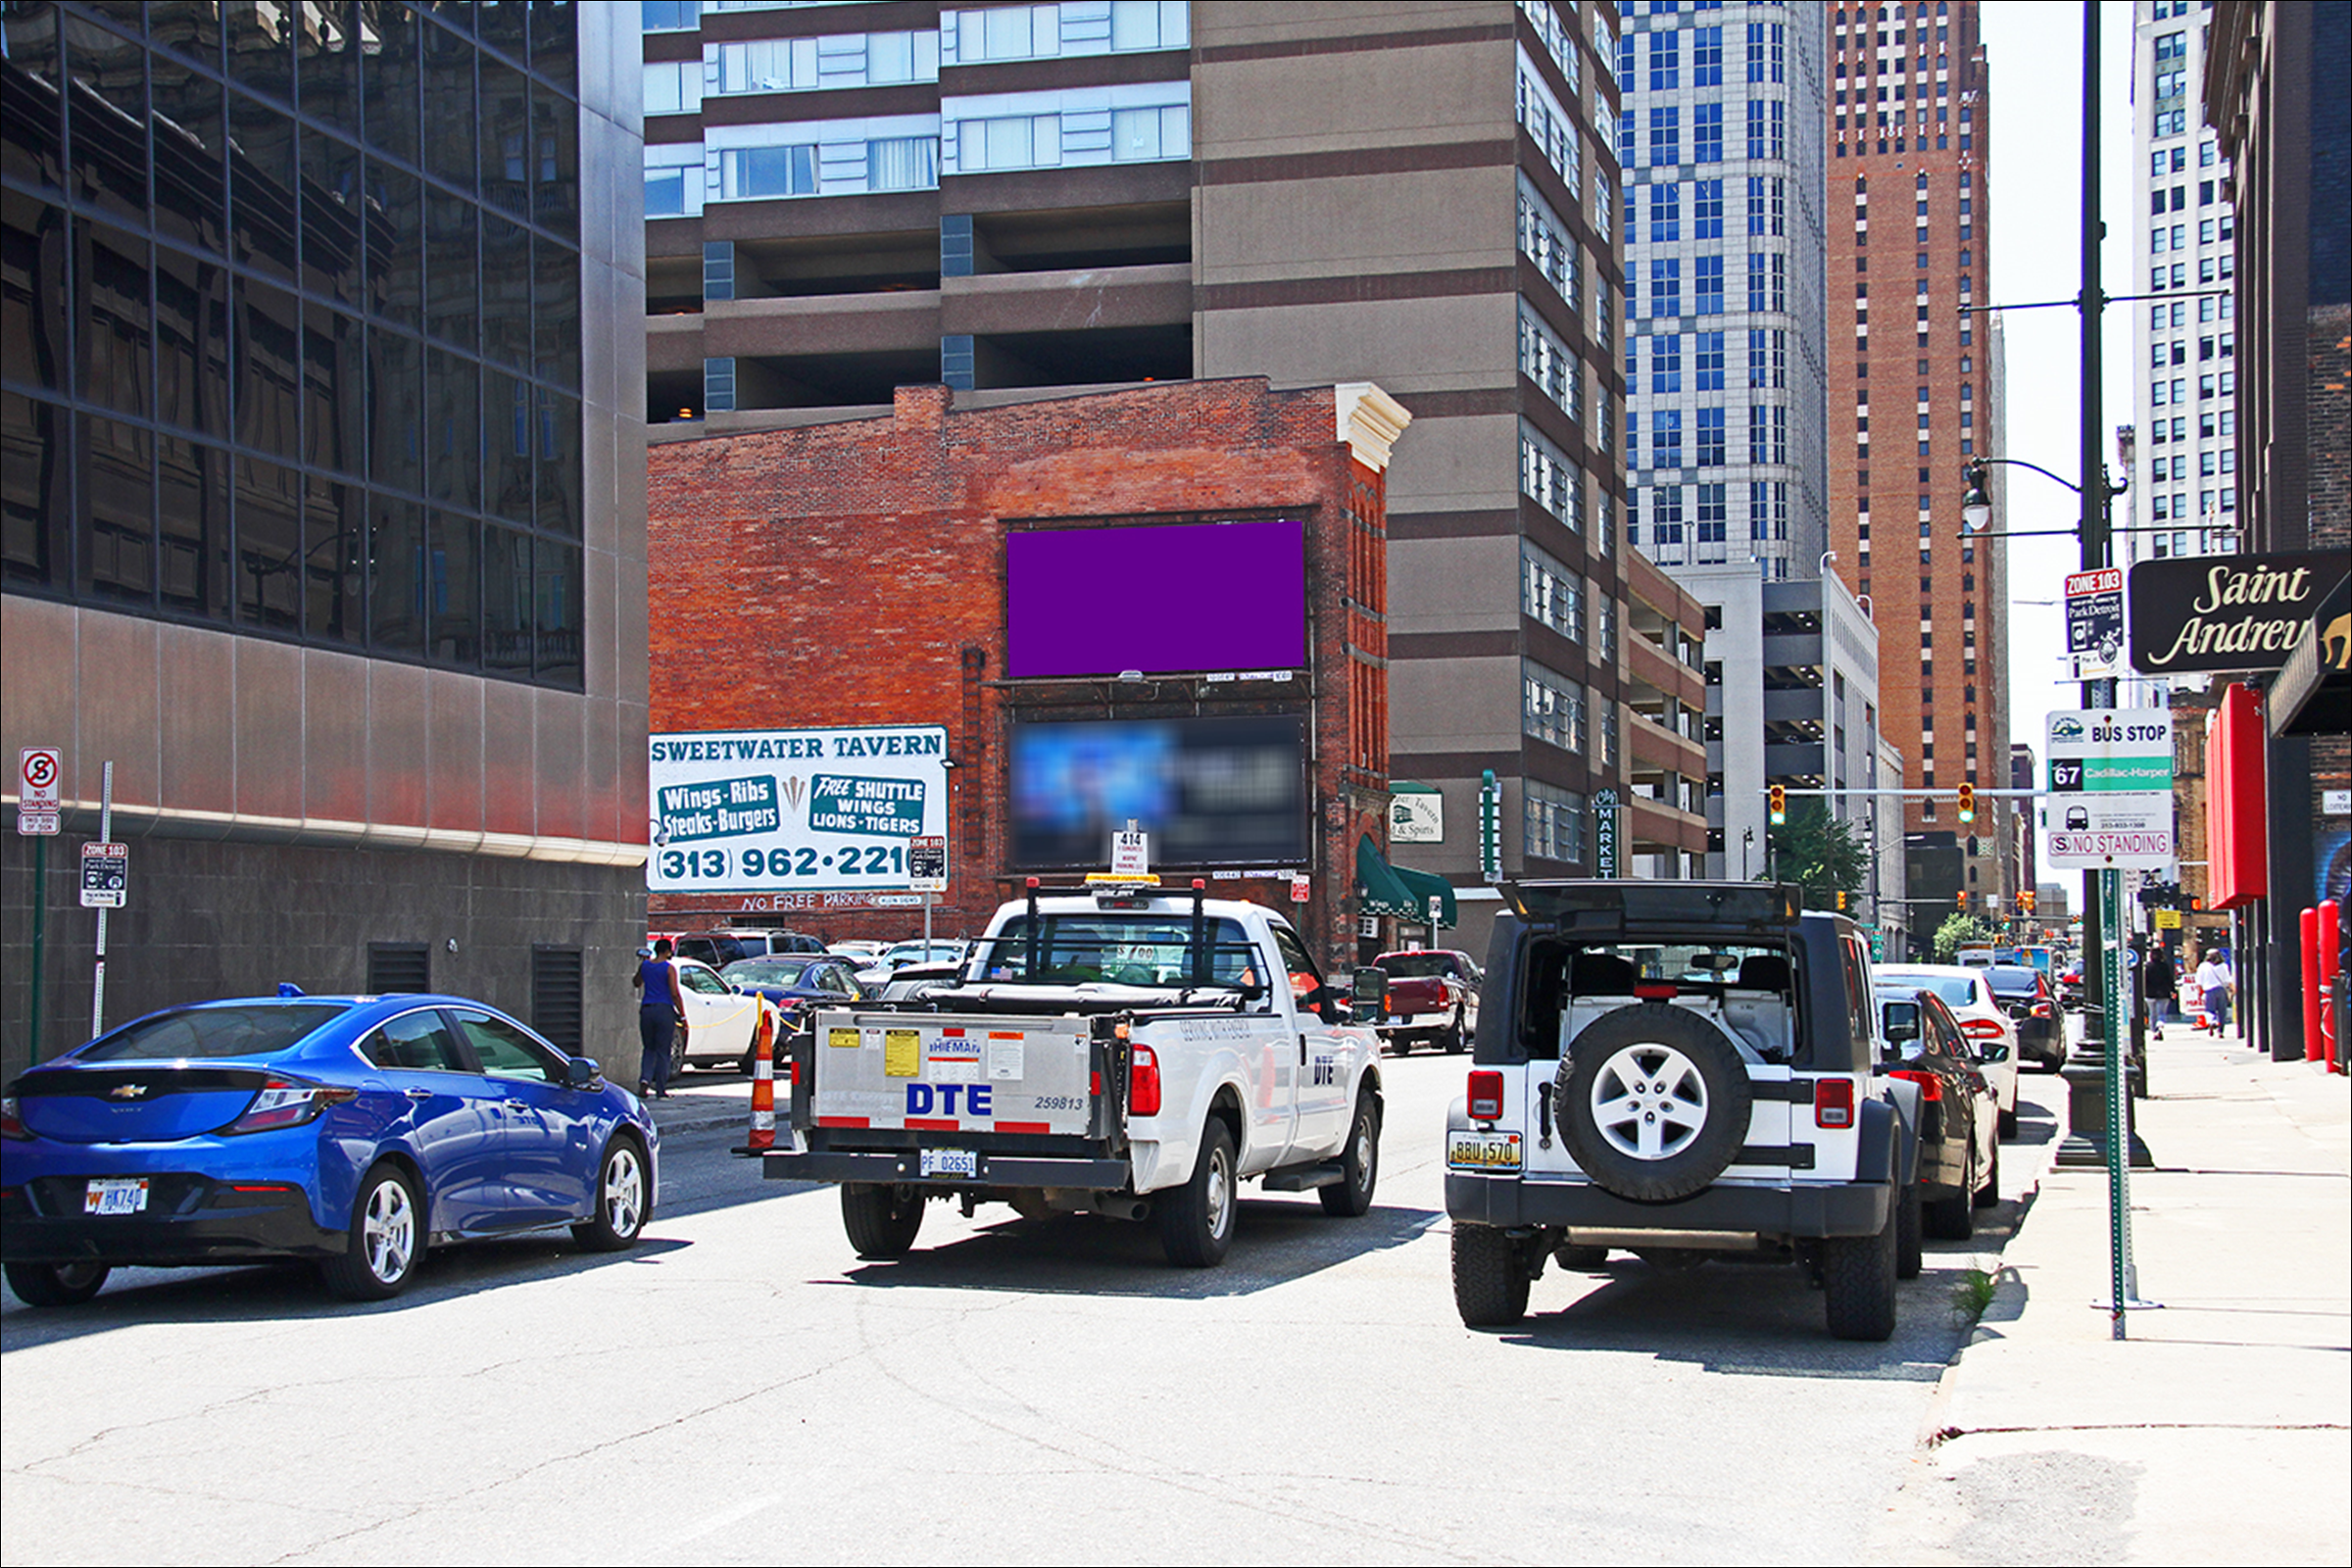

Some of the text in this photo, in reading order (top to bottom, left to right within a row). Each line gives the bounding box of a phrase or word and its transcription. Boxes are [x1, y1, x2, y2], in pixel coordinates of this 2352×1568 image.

[2068, 571, 2120, 594] ZONE 103
[2193, 564, 2311, 613] Saint
[2092, 726, 2123, 742] BUS
[2127, 725, 2167, 742] STOP
[652, 735, 942, 760] SWEETWATER TAVERN
[2054, 766, 2080, 785] 67
[2084, 767, 2170, 779] Cadillac-Harper
[814, 777, 924, 802] FREE SHUTTLE
[837, 801, 896, 815] WINGS
[1415, 796, 1440, 824] Tavern
[1120, 833, 1141, 845] 414
[1599, 808, 1613, 879] MARKET
[2074, 835, 2093, 853] NO
[2097, 834, 2167, 853] STANDING
[85, 846, 125, 856] ZONE 103
[656, 849, 733, 879] (313)
[741, 893, 875, 910] NO FREE PARKING
[1314, 1055, 1334, 1085] DTE
[906, 1083, 993, 1116] DTE
[1034, 1097, 1083, 1110] 259813
[922, 1155, 975, 1171] PF 02651
